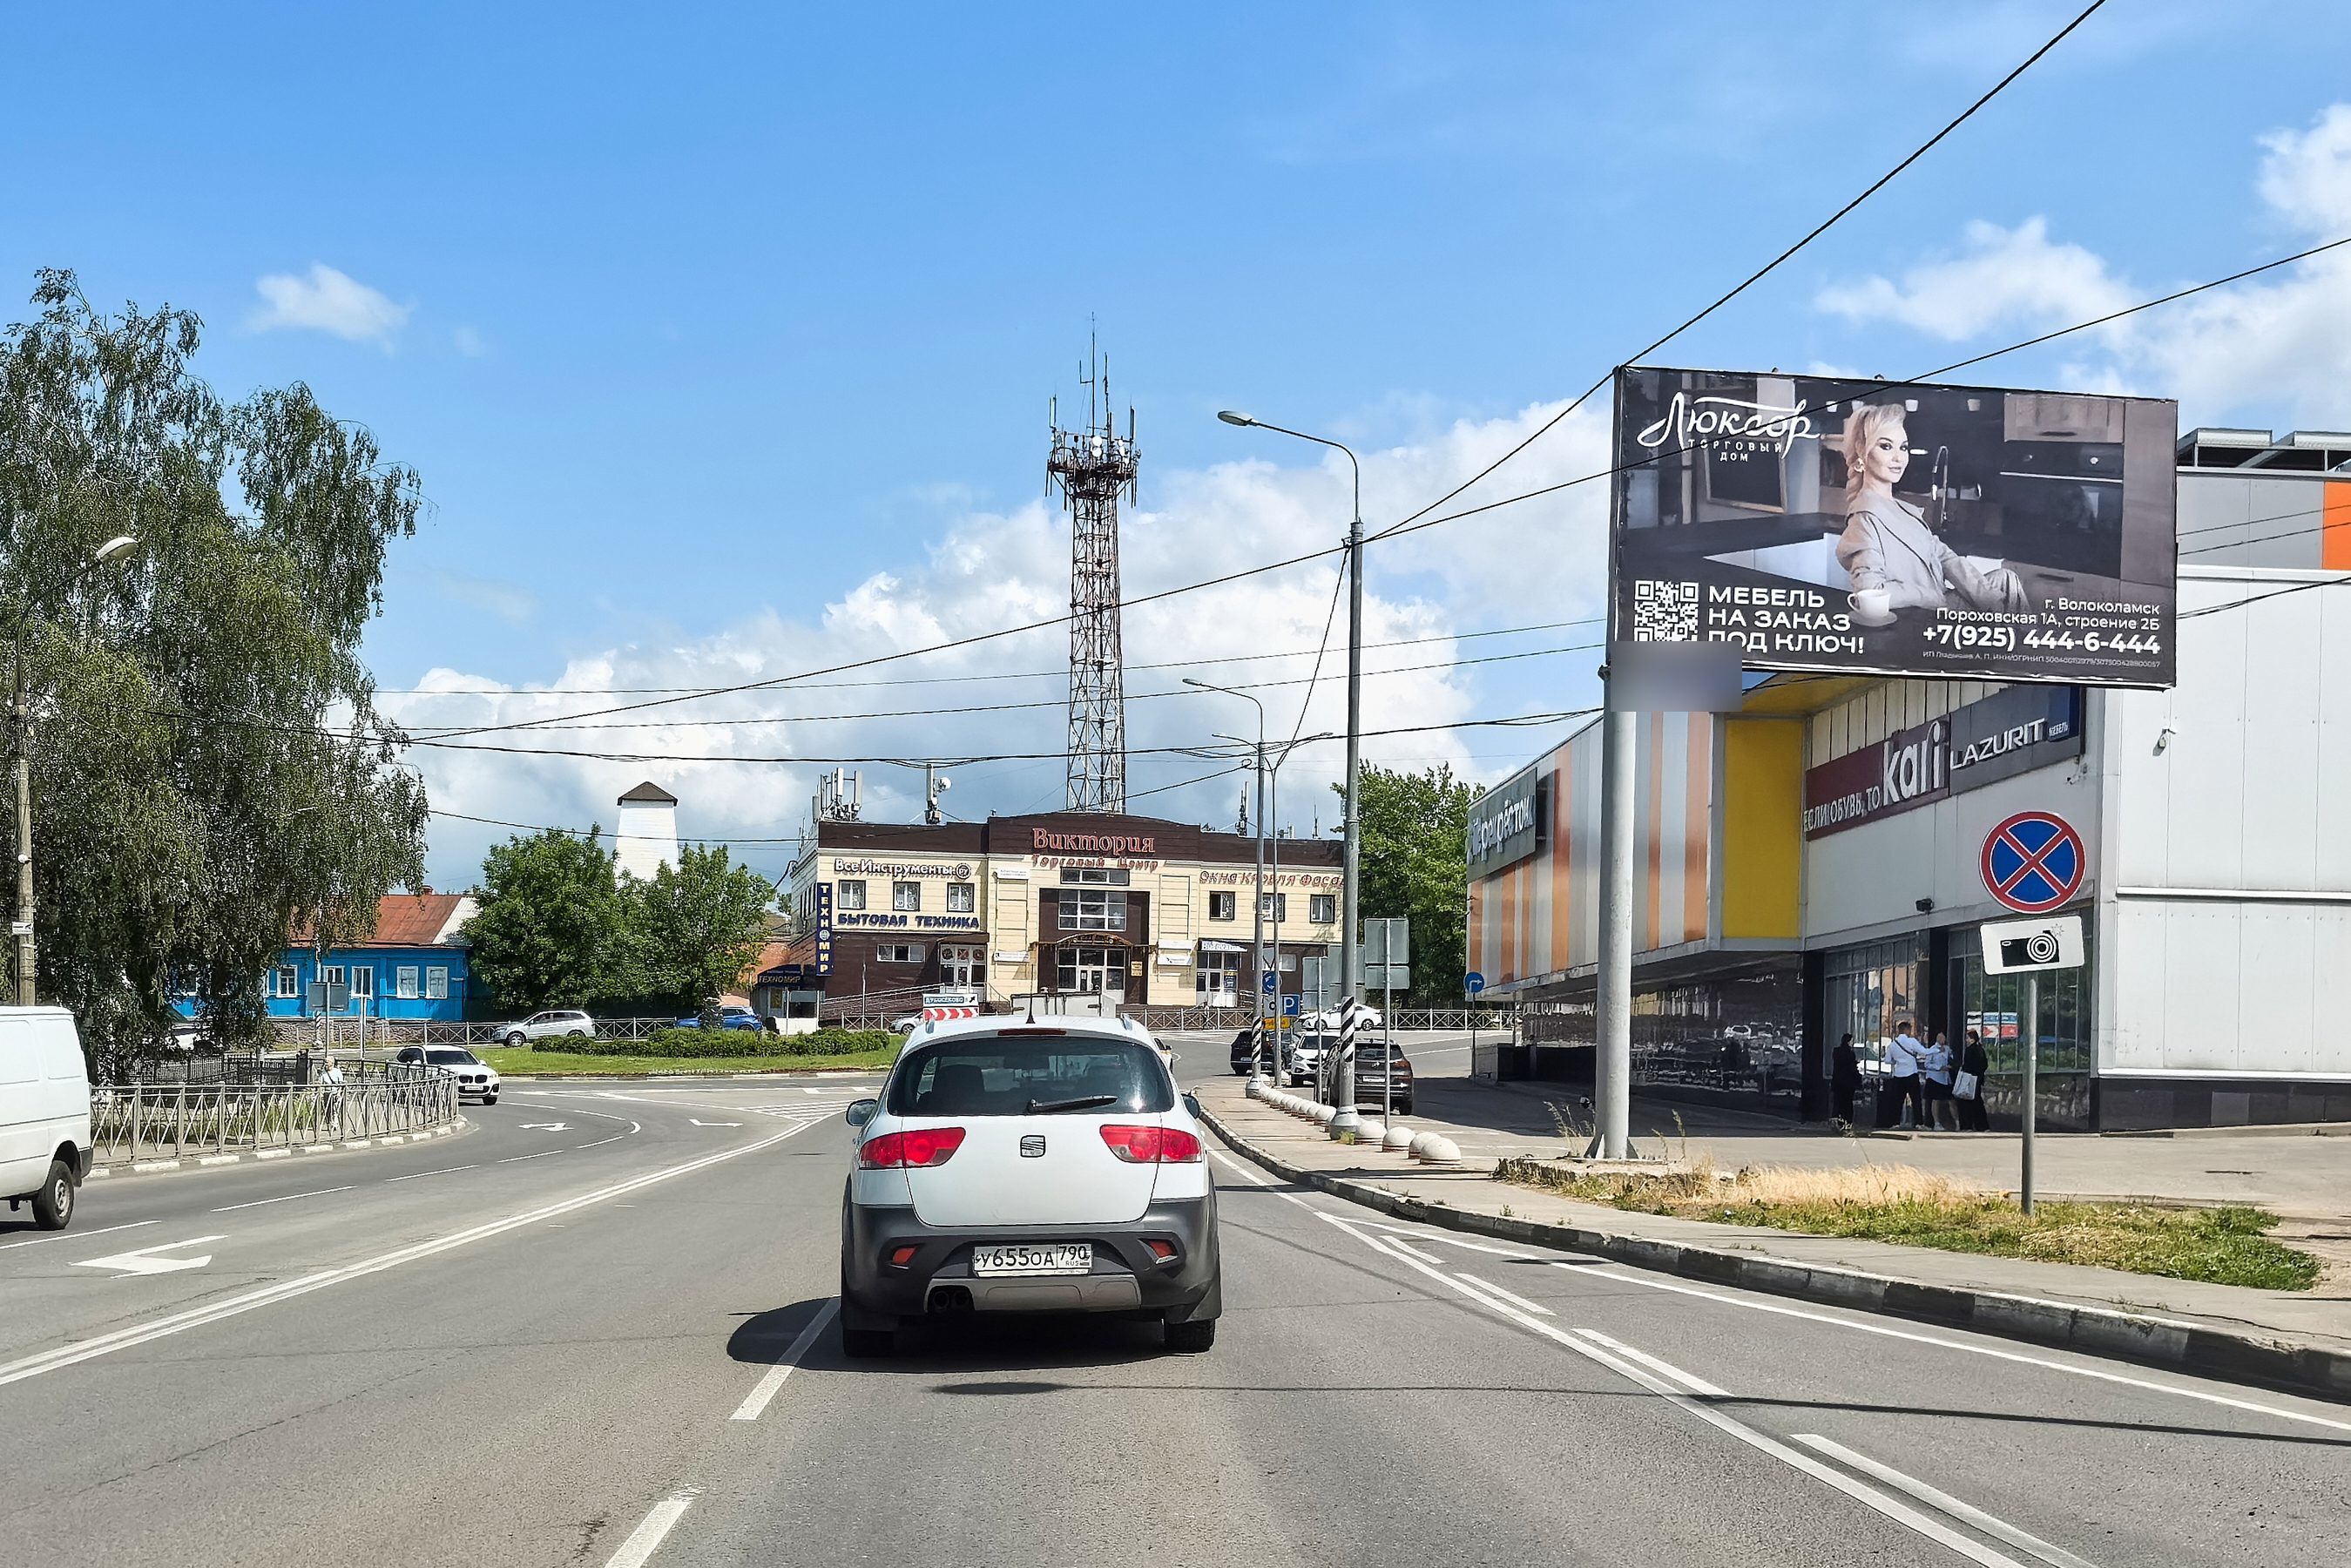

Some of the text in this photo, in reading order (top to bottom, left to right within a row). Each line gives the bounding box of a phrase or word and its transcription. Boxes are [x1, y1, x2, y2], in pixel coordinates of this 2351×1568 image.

[1637, 392, 1821, 459] Люксор
[1688, 439, 1782, 453] ТОРГОВЫЙ
[1719, 452, 1749, 462] ДОМ
[1708, 585, 1825, 608] МЕБЕЛЬ
[2044, 597, 2160, 615] г. Волоколамск
[1708, 608, 1851, 632] НА ЗАКАЗ
[1936, 607, 2160, 630] Пороховская 1А, строение 2Б
[1775, 632, 1865, 654] КЛЮЧ!
[1922, 625, 2161, 654] +7(925) 444-6-444
[1949, 718, 2046, 771] LAZURIT
[1883, 720, 1944, 807] kari
[1803, 805, 1829, 833] ЕСЛИ
[1867, 786, 1881, 812] ТО
[1032, 828, 1156, 855] Виктория
[1031, 853, 1159, 874] Торговый Центр
[837, 913, 980, 929] БЫТОВАЯ ТЕХНИКА
[1058, 1246, 1087, 1261] 790
